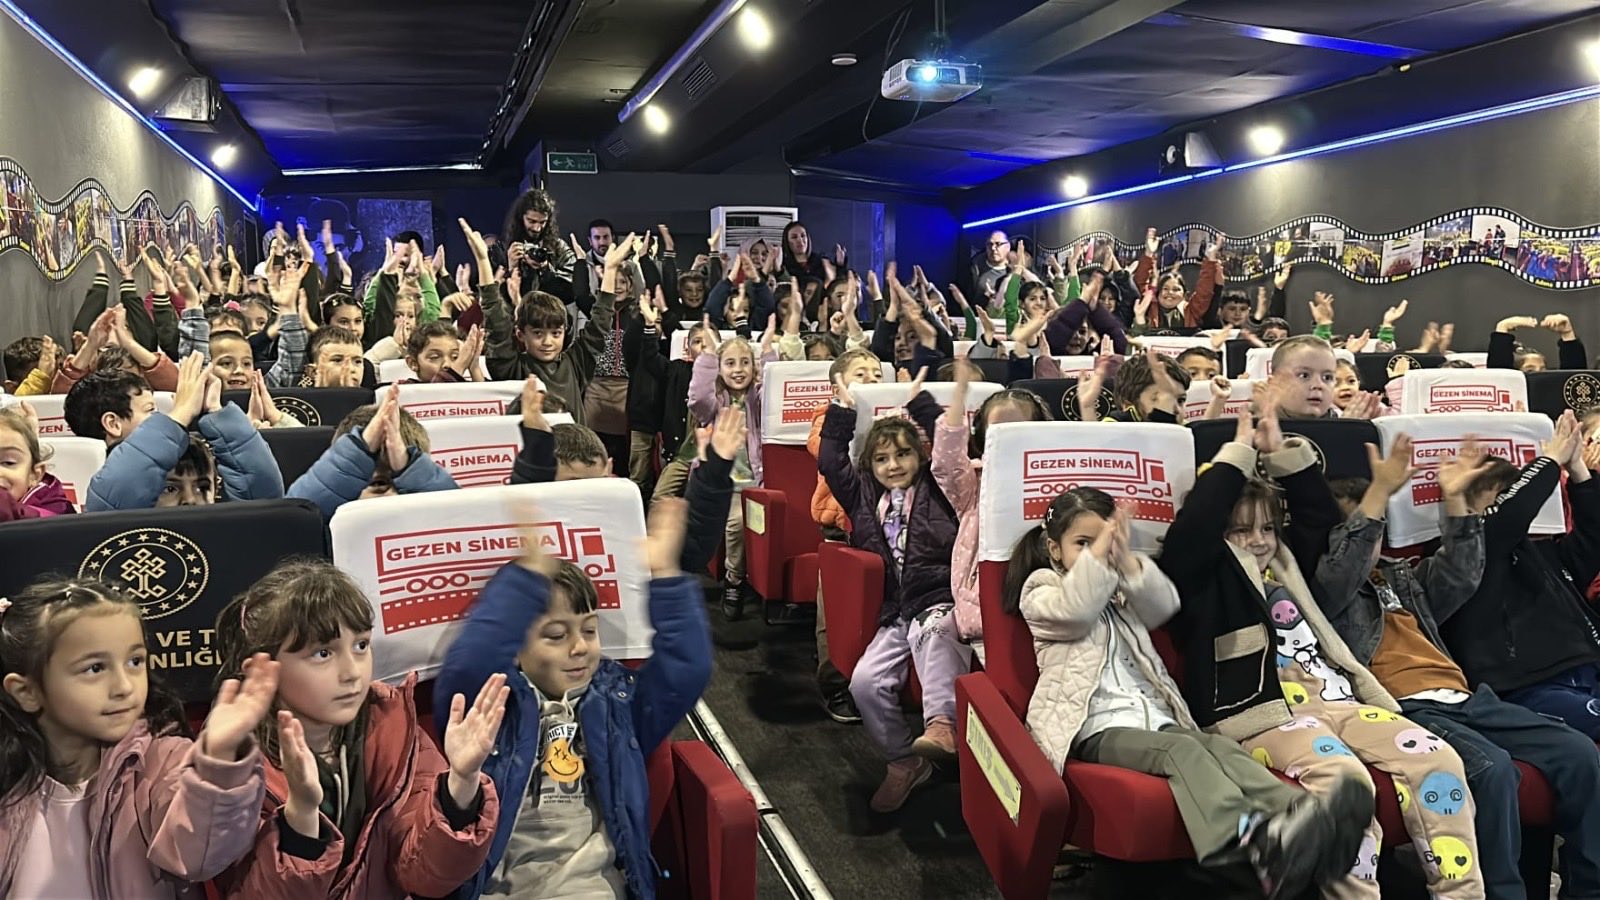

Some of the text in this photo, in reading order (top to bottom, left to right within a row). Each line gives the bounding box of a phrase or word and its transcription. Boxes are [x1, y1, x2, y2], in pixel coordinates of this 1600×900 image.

[788, 385, 818, 393] GEZEN
[1461, 389, 1493, 398] SİNEMA
[449, 406, 498, 416] SİNEMA
[39, 424, 64, 433] ZEN
[450, 453, 513, 468] SİNEMA
[1030, 456, 1135, 470] GEZEN SİNEMA
[386, 541, 463, 562] GEZEN
[155, 630, 192, 648] VE
[149, 646, 222, 670] NLIĞI
